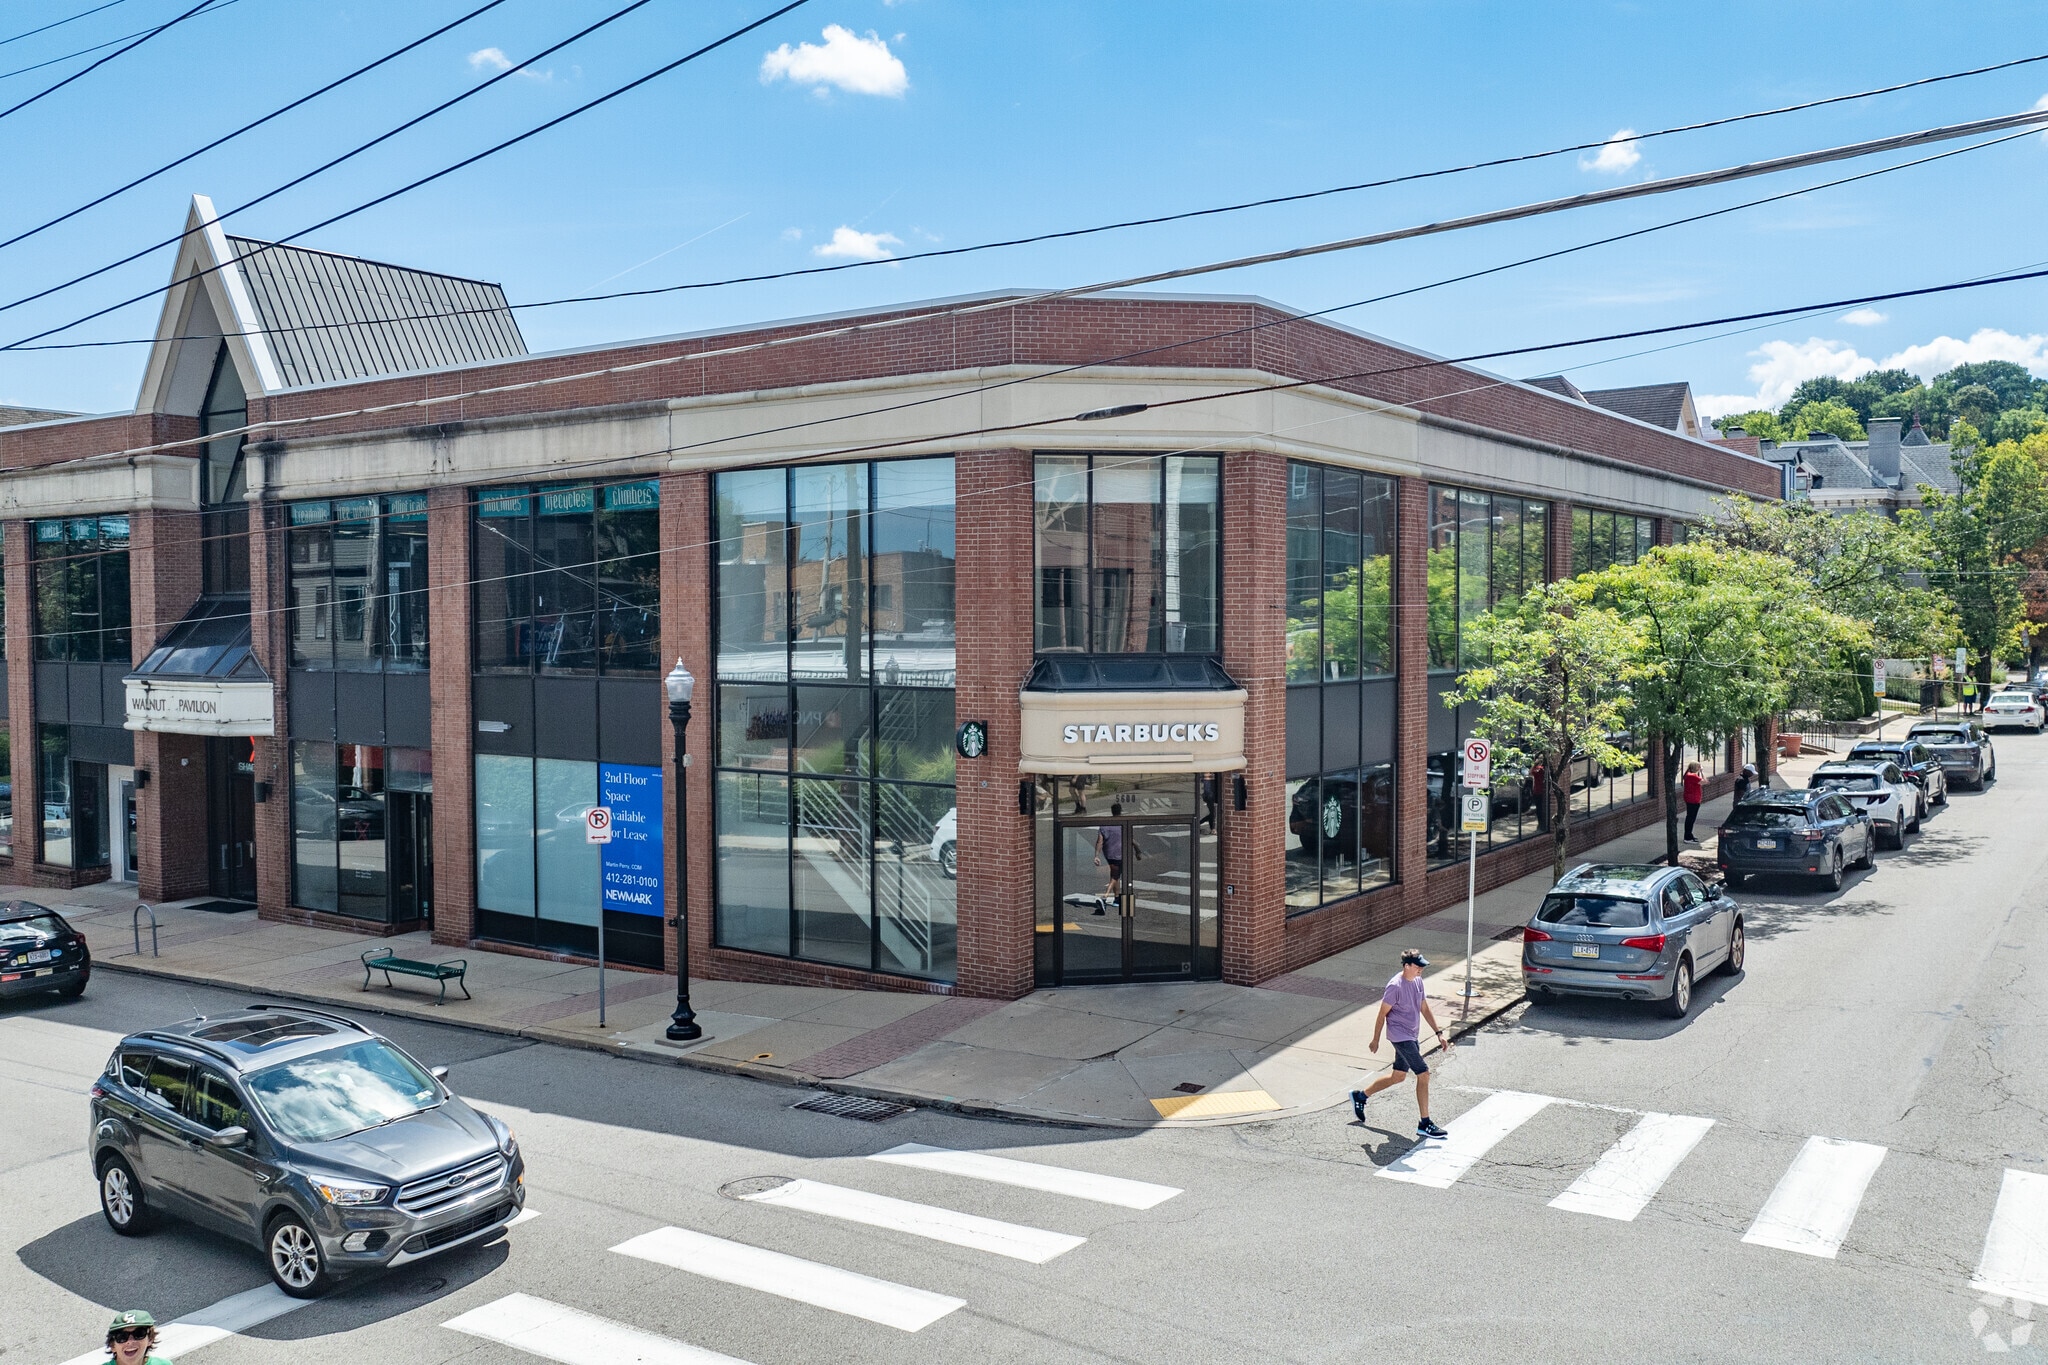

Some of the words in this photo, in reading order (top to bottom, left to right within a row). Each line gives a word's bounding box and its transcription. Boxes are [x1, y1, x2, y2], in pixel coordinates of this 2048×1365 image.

[544, 491, 587, 511] lifecycles
[612, 486, 652, 506] climbers
[132, 698, 166, 712] WALNUT
[178, 699, 217, 714] PAVILION
[1063, 723, 1219, 744] STARBUCKS
[604, 771, 622, 783] 2nd
[624, 773, 648, 786] Floor
[605, 788, 631, 805] Space
[611, 809, 646, 823] vailable
[611, 829, 622, 839] or
[623, 827, 648, 841] Lease
[605, 872, 658, 888] 412-281-0100
[605, 888, 653, 906] NEWMARK
